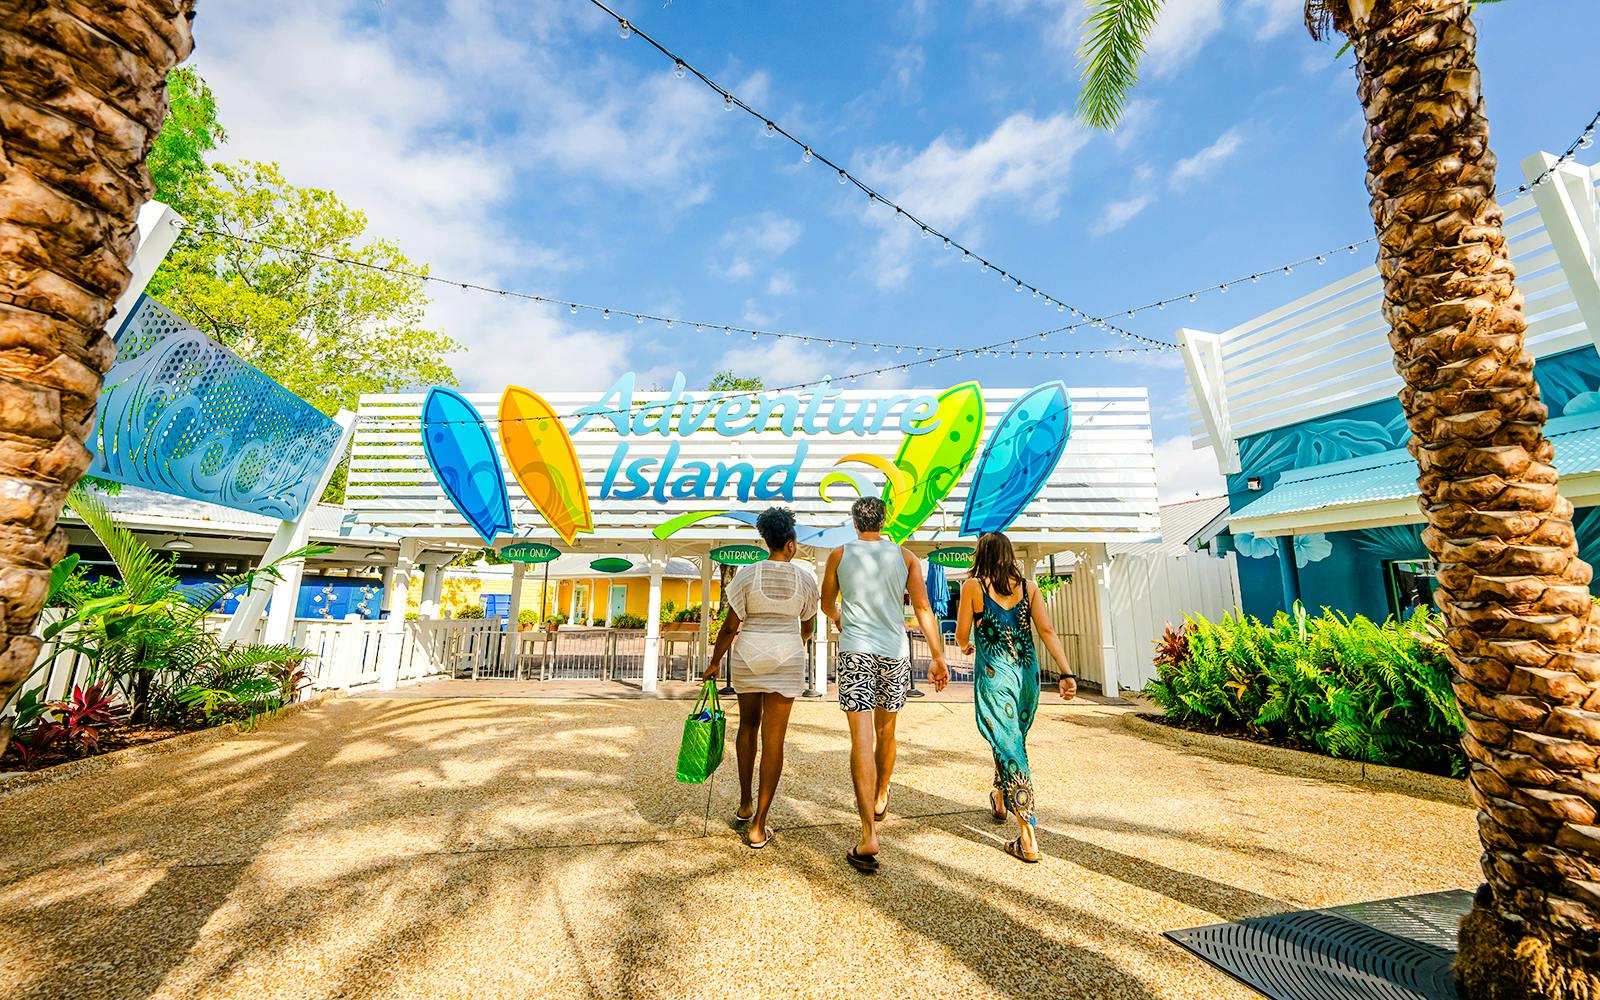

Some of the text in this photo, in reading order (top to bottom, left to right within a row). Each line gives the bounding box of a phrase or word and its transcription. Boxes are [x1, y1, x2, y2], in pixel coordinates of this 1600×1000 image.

[568, 372, 942, 437] Adventure
[600, 439, 809, 504] Island
[508, 547, 551, 558] EXIT ONLY
[718, 550, 761, 561] ENTRANCE
[938, 552, 976, 563] ENTRAN
